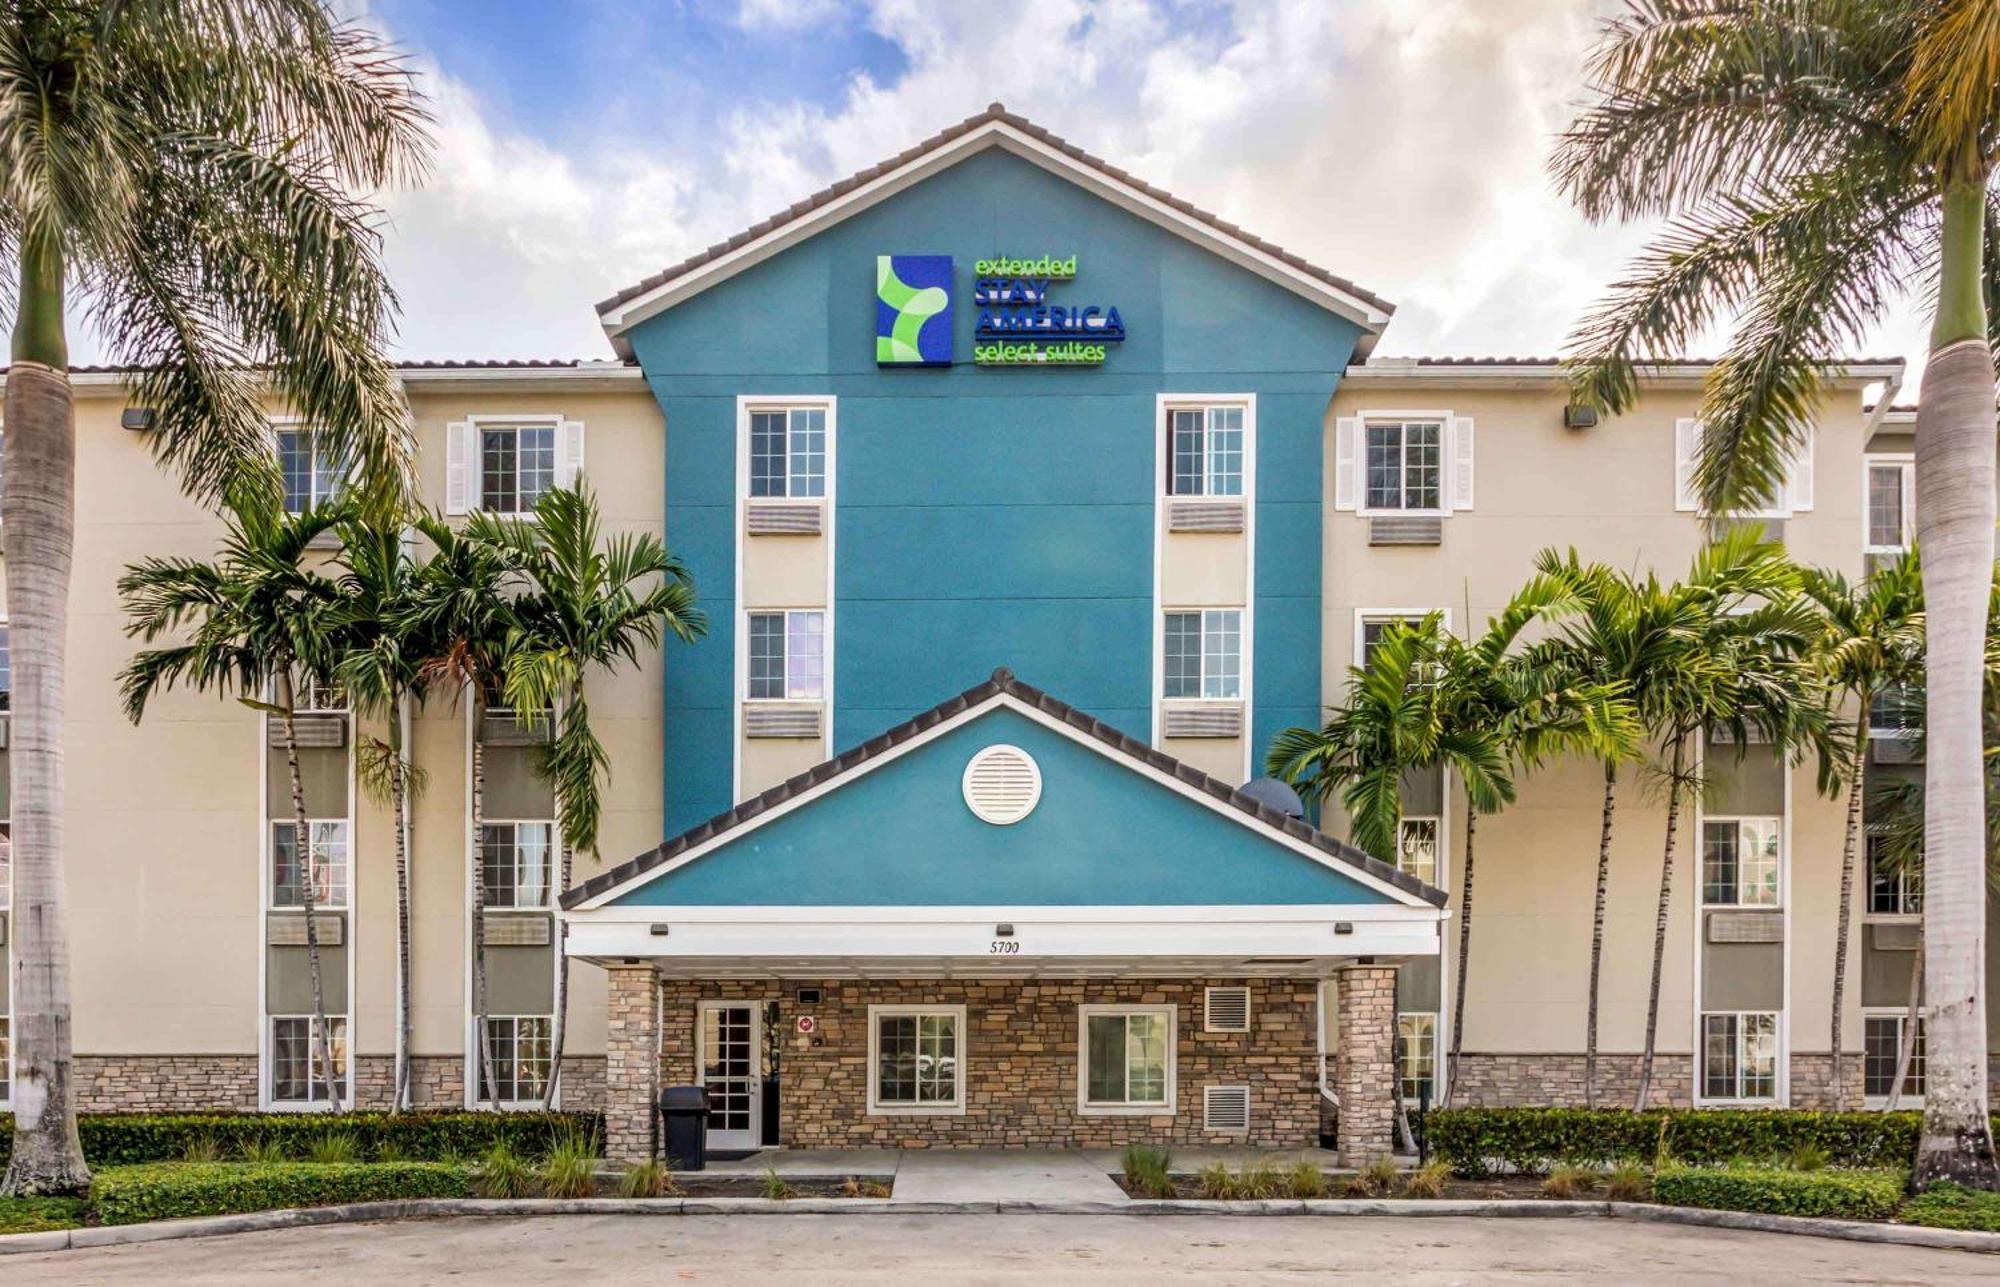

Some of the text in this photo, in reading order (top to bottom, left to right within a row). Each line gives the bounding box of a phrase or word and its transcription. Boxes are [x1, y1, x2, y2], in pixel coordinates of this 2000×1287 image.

[975, 255, 1077, 276] extended
[975, 279, 1049, 305] STAY
[975, 306, 1125, 335] AMERICA
[975, 341, 1105, 362] select suites
[990, 941, 1020, 953] 5700
